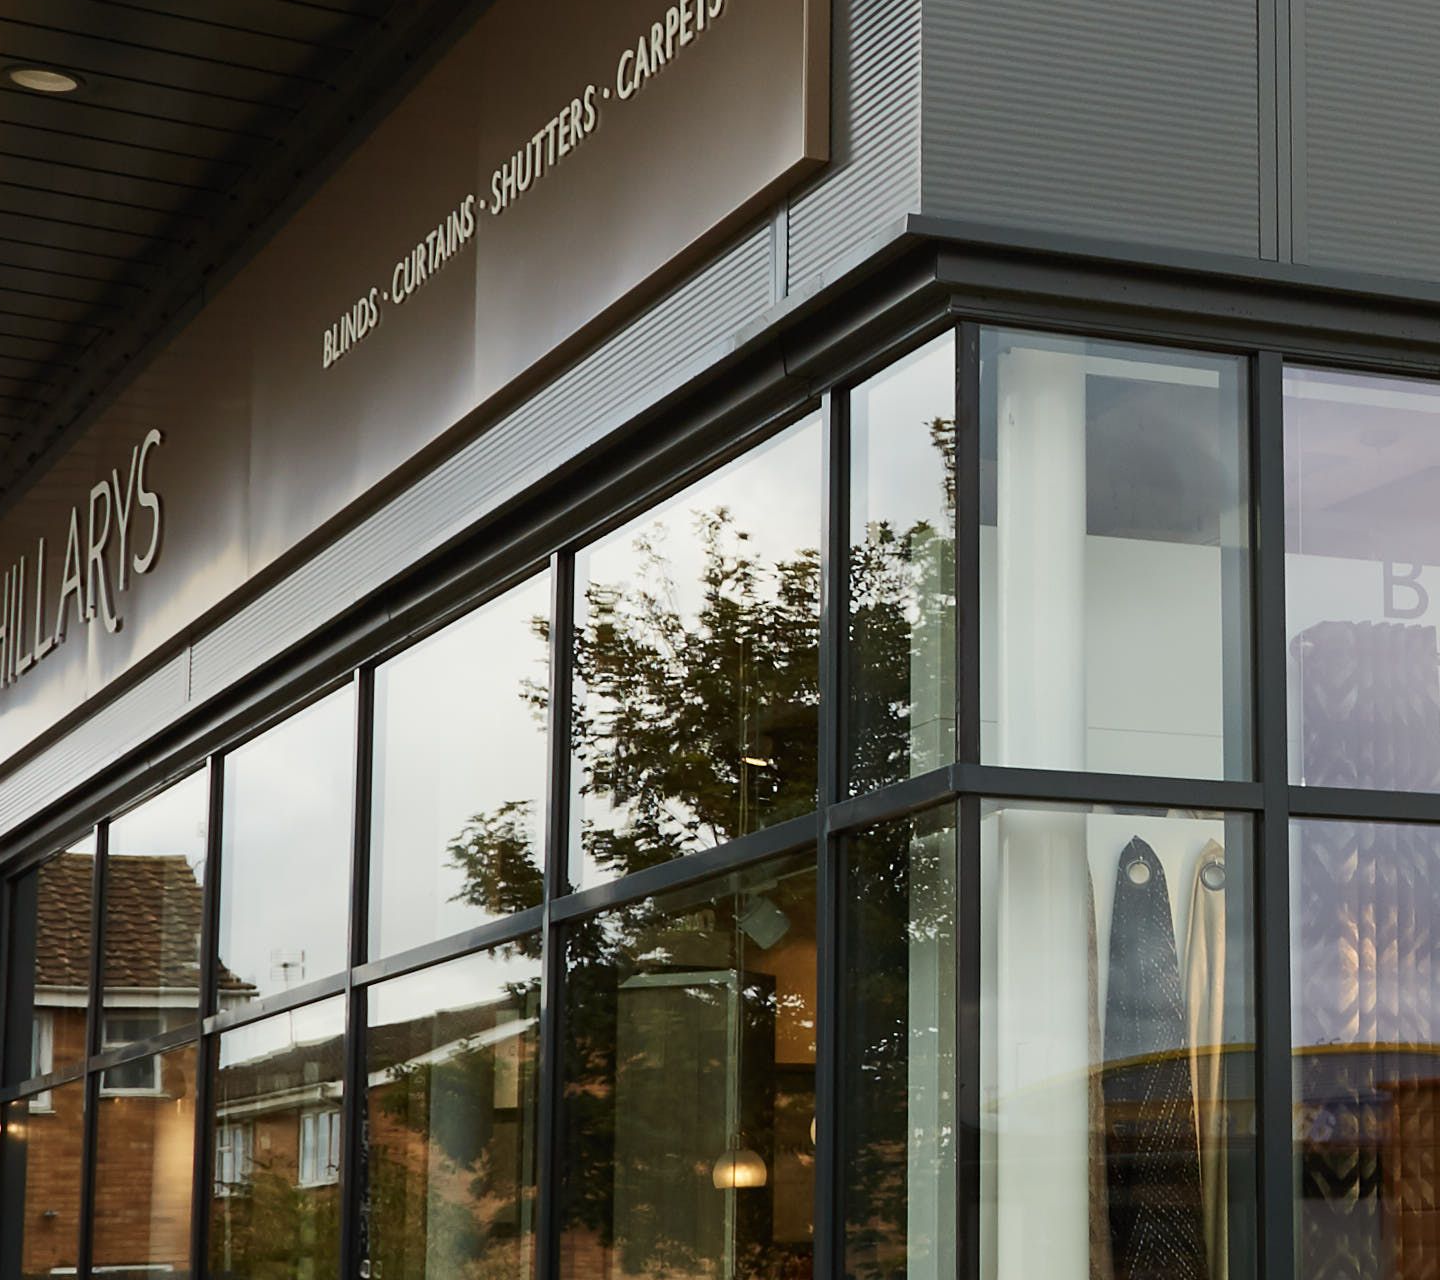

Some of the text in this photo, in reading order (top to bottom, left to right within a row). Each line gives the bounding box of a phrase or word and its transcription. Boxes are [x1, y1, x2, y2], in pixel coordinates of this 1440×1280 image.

[323, 287, 379, 368] BLINDS
[392, 195, 475, 303] CURTAINS
[490, 86, 597, 215] SHUTTERS
